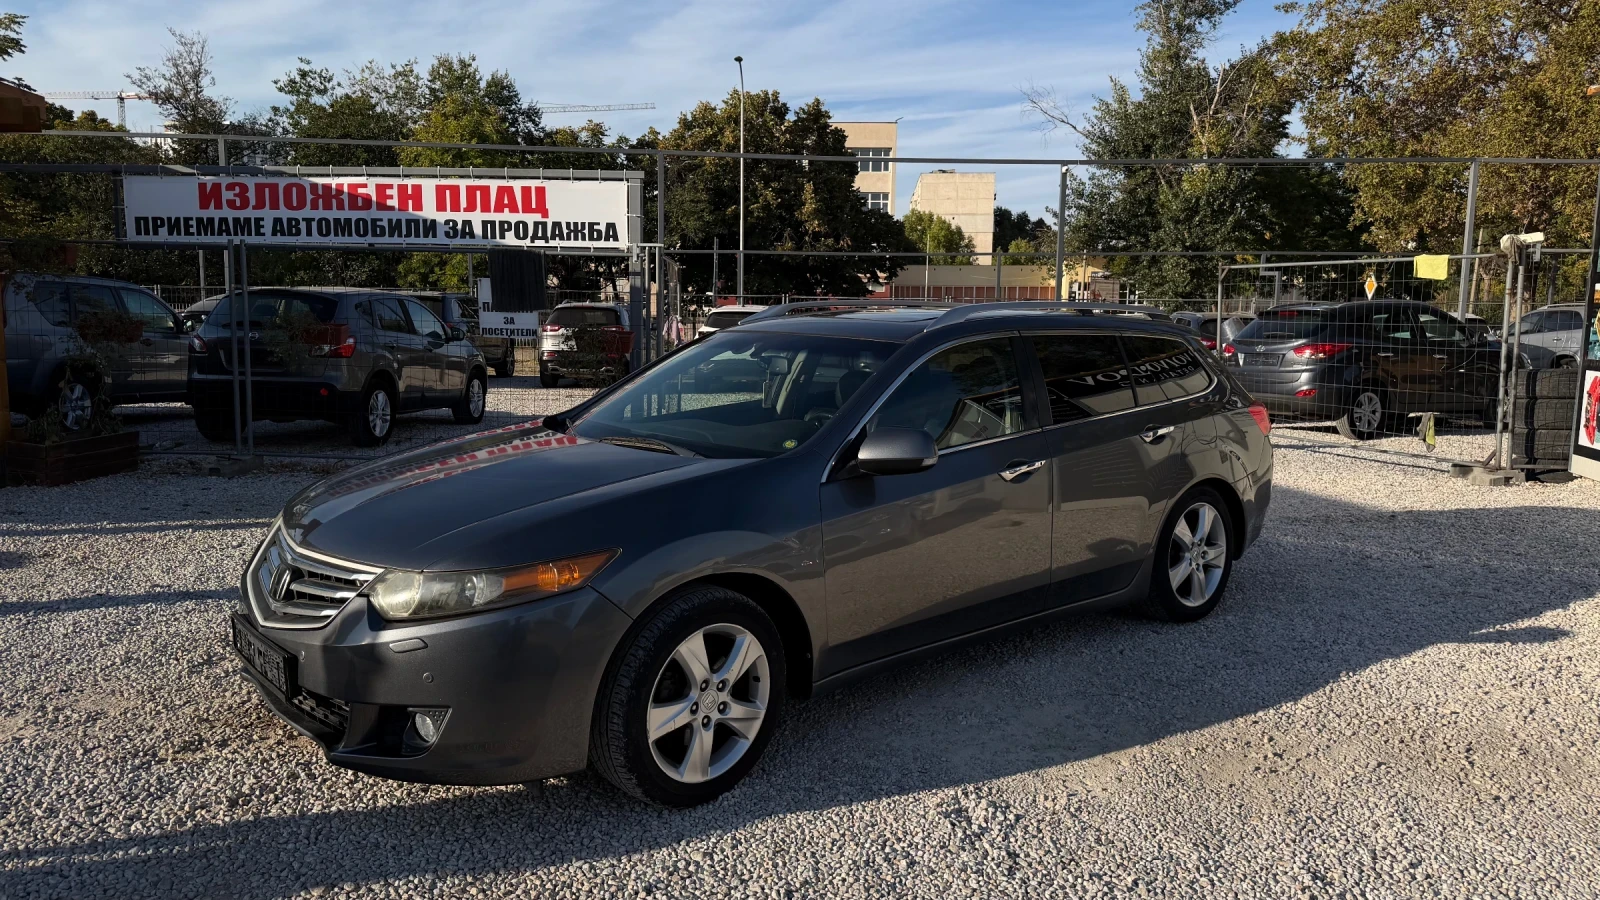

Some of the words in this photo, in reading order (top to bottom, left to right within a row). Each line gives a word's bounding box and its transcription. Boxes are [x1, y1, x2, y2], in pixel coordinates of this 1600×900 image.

[197, 181, 424, 212] ИЗЛОЖБЕН
[435, 184, 550, 218] ПЛАЦ
[134, 216, 266, 237] ПРИЕМАМЕ
[270, 217, 438, 240] АВТОМОБИЛИ
[443, 219, 476, 240] ЗА
[481, 220, 620, 243] ПРОДАЖБА
[503, 316, 516, 325] ЗА
[481, 327, 538, 337] ПОСЕТИТЕЛИ
